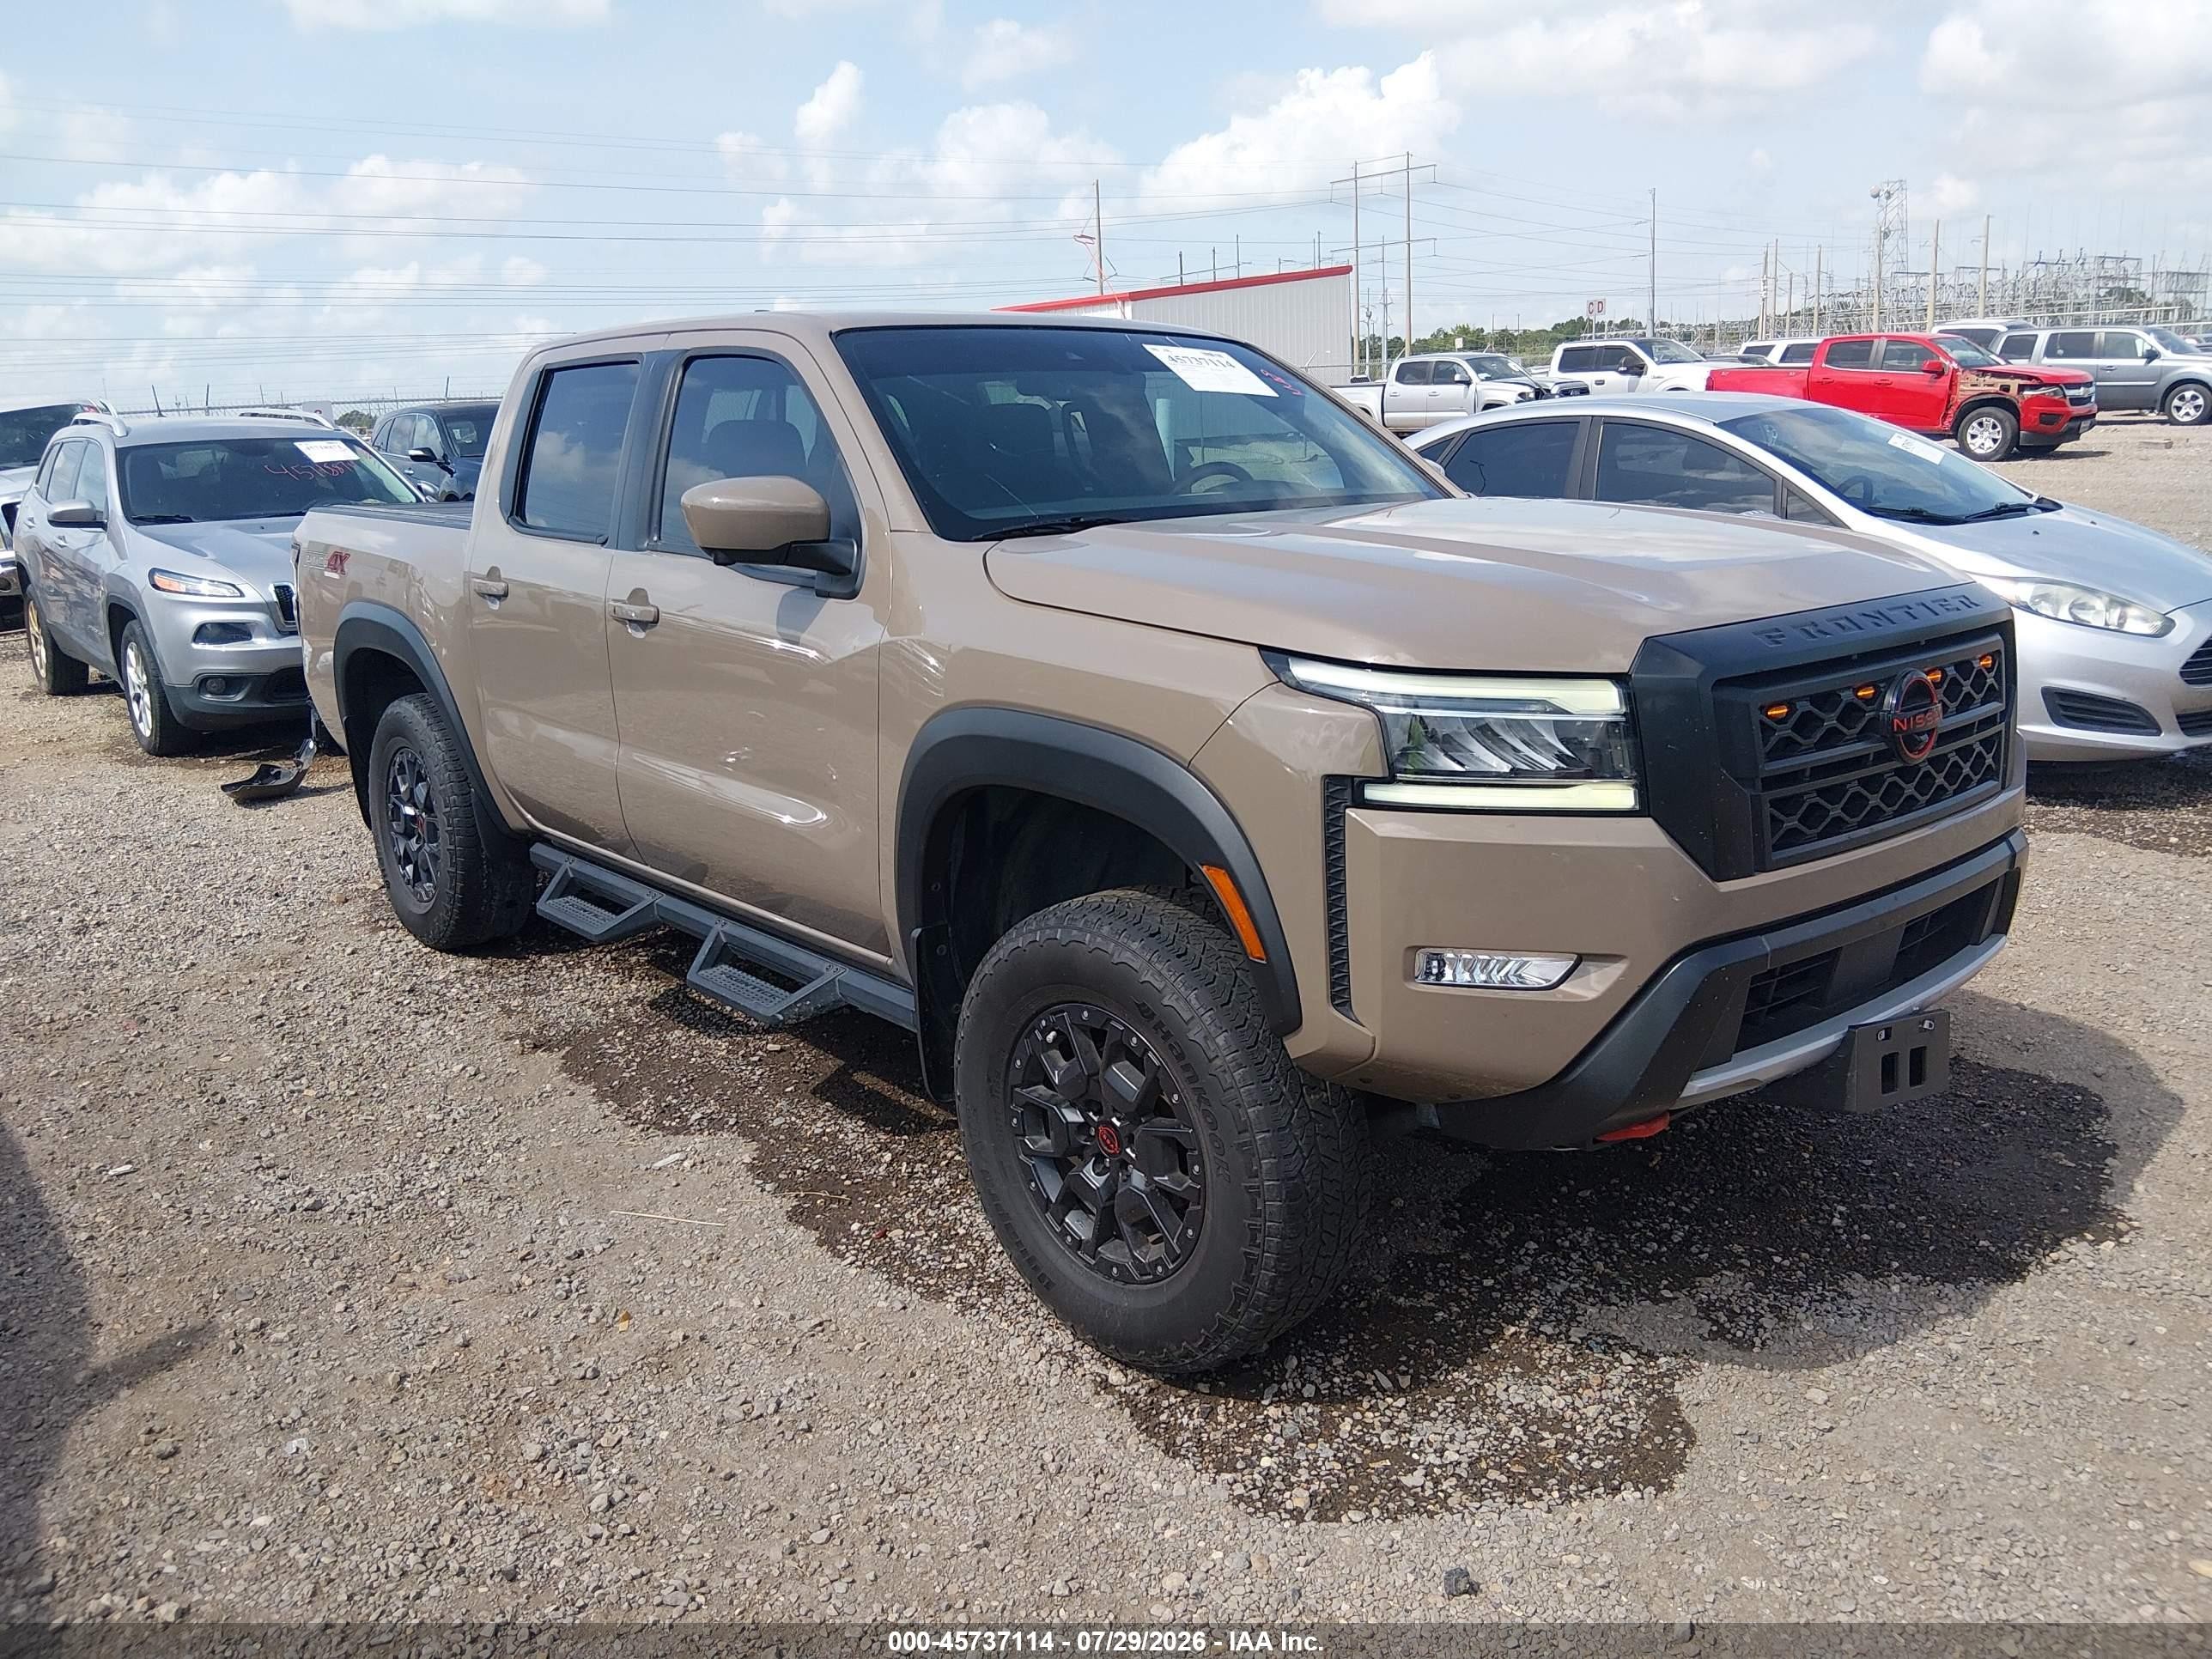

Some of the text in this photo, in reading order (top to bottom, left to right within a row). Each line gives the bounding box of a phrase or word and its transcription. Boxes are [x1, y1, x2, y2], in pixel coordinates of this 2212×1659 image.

[1588, 301, 1594, 314] C
[1597, 301, 1604, 313] D
[1168, 354, 1236, 369] 45737114
[1753, 593, 1981, 647] FRONTIER
[1893, 709, 1940, 732] NISS
